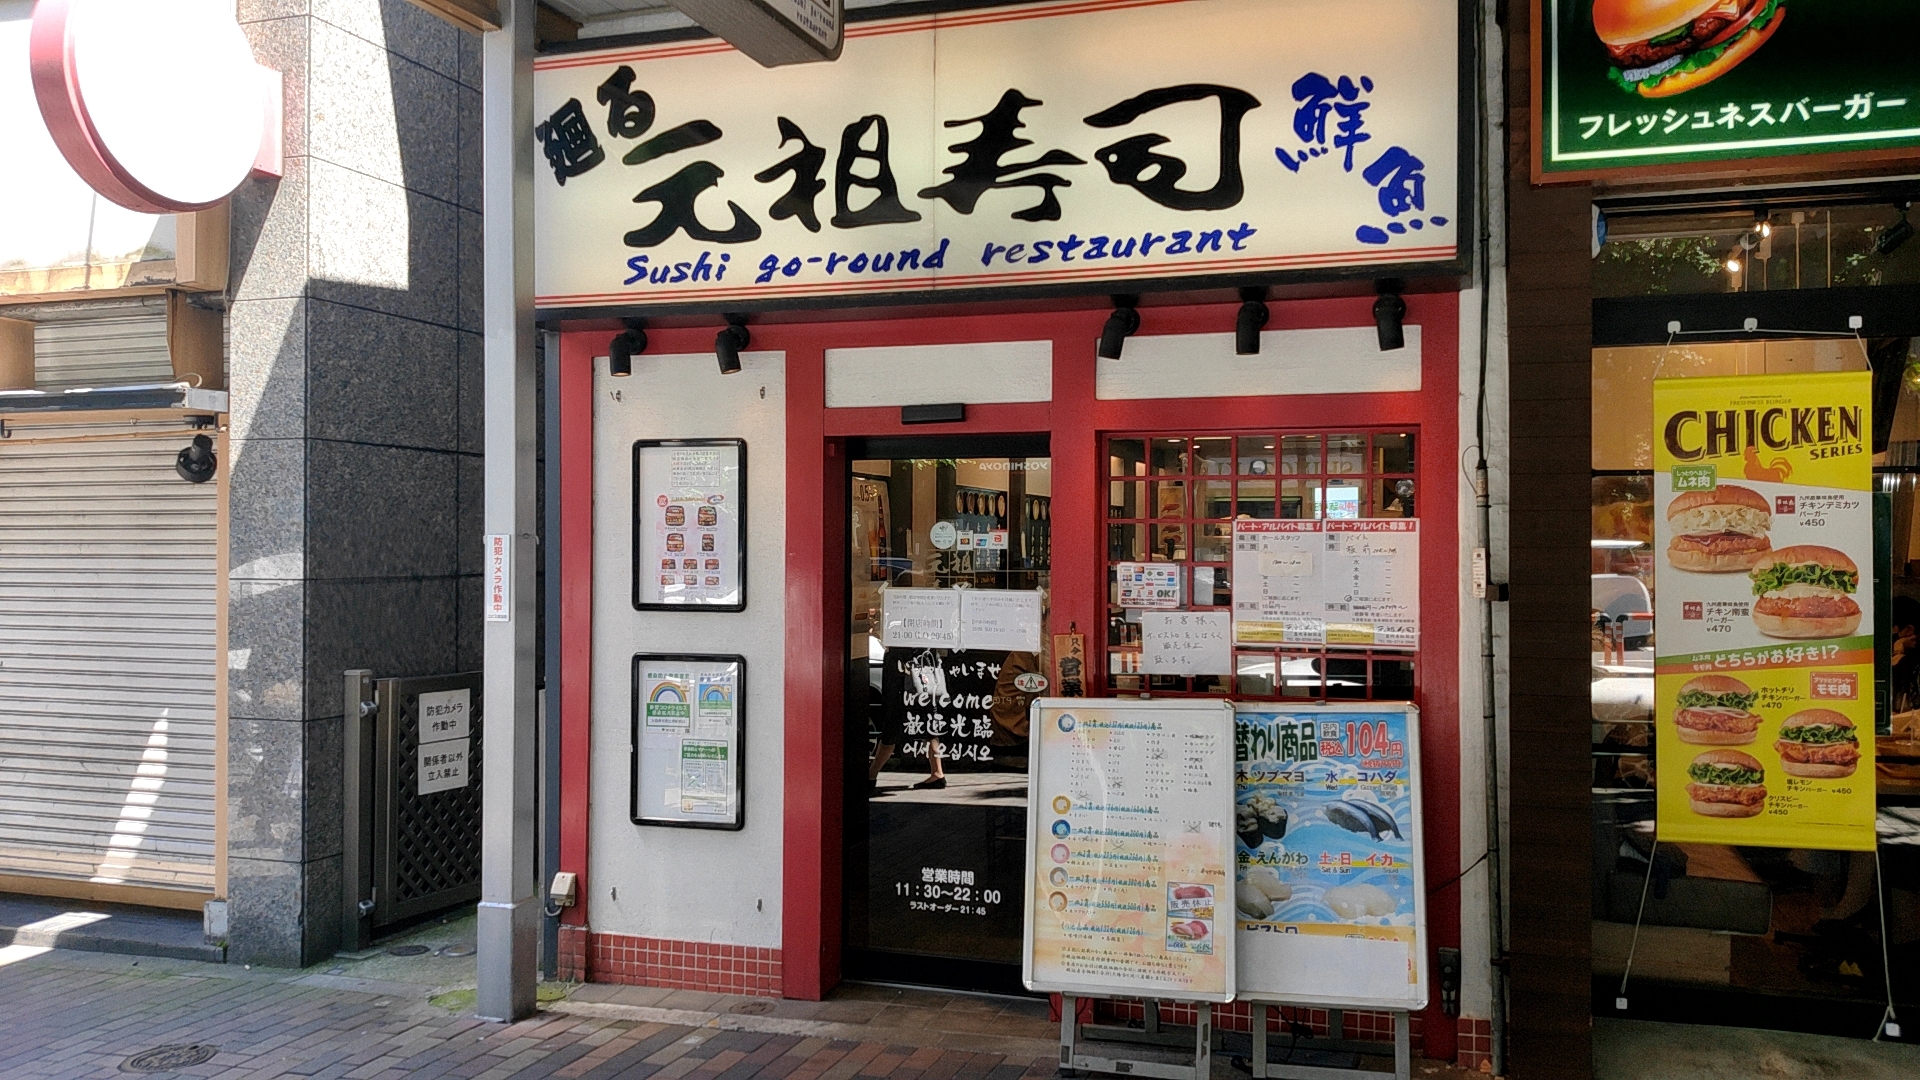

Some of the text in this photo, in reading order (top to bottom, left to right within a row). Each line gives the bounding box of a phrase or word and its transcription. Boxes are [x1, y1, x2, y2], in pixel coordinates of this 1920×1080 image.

[1579, 92, 1908, 140] フレッシュネスバーガー
[1275, 72, 1449, 244] 鮮魚
[622, 84, 1262, 248] 元祖寿司
[624, 222, 1258, 285] Sushi go-round restaurant
[1664, 406, 1863, 461] CHICKEN
[1809, 443, 1863, 460] SERIES
[1677, 476, 1711, 488] ムネ肉
[1799, 501, 1860, 510] チキンデミカツ
[1799, 518, 1826, 527] ¥450
[493, 536, 503, 612] 防犯カメラ作動中
[1156, 589, 1176, 598] OK!
[1706, 608, 1750, 616] チキン南蛮
[1706, 625, 1732, 633] ¥470
[1070, 637, 1082, 656] 只今
[1714, 644, 1840, 668] どちらがお好き!?
[1816, 683, 1852, 696] モモ肉
[426, 702, 464, 717] 防犯カメラ
[432, 719, 458, 733] 作動中
[1322, 723, 1338, 731] 店内
[1320, 721, 1404, 758] 税込 104円
[423, 751, 464, 768] 関係者以外
[427, 767, 460, 781] 立入禁止
[1237, 770, 1305, 783] 木 ツブマヨ
[1325, 770, 1398, 783] 水 コハダ
[1237, 851, 1309, 865] 金 えんがわ
[1318, 851, 1394, 866] 土・日 イカ
[921, 867, 975, 886] 営業時間
[1170, 899, 1213, 910] 販売休止
